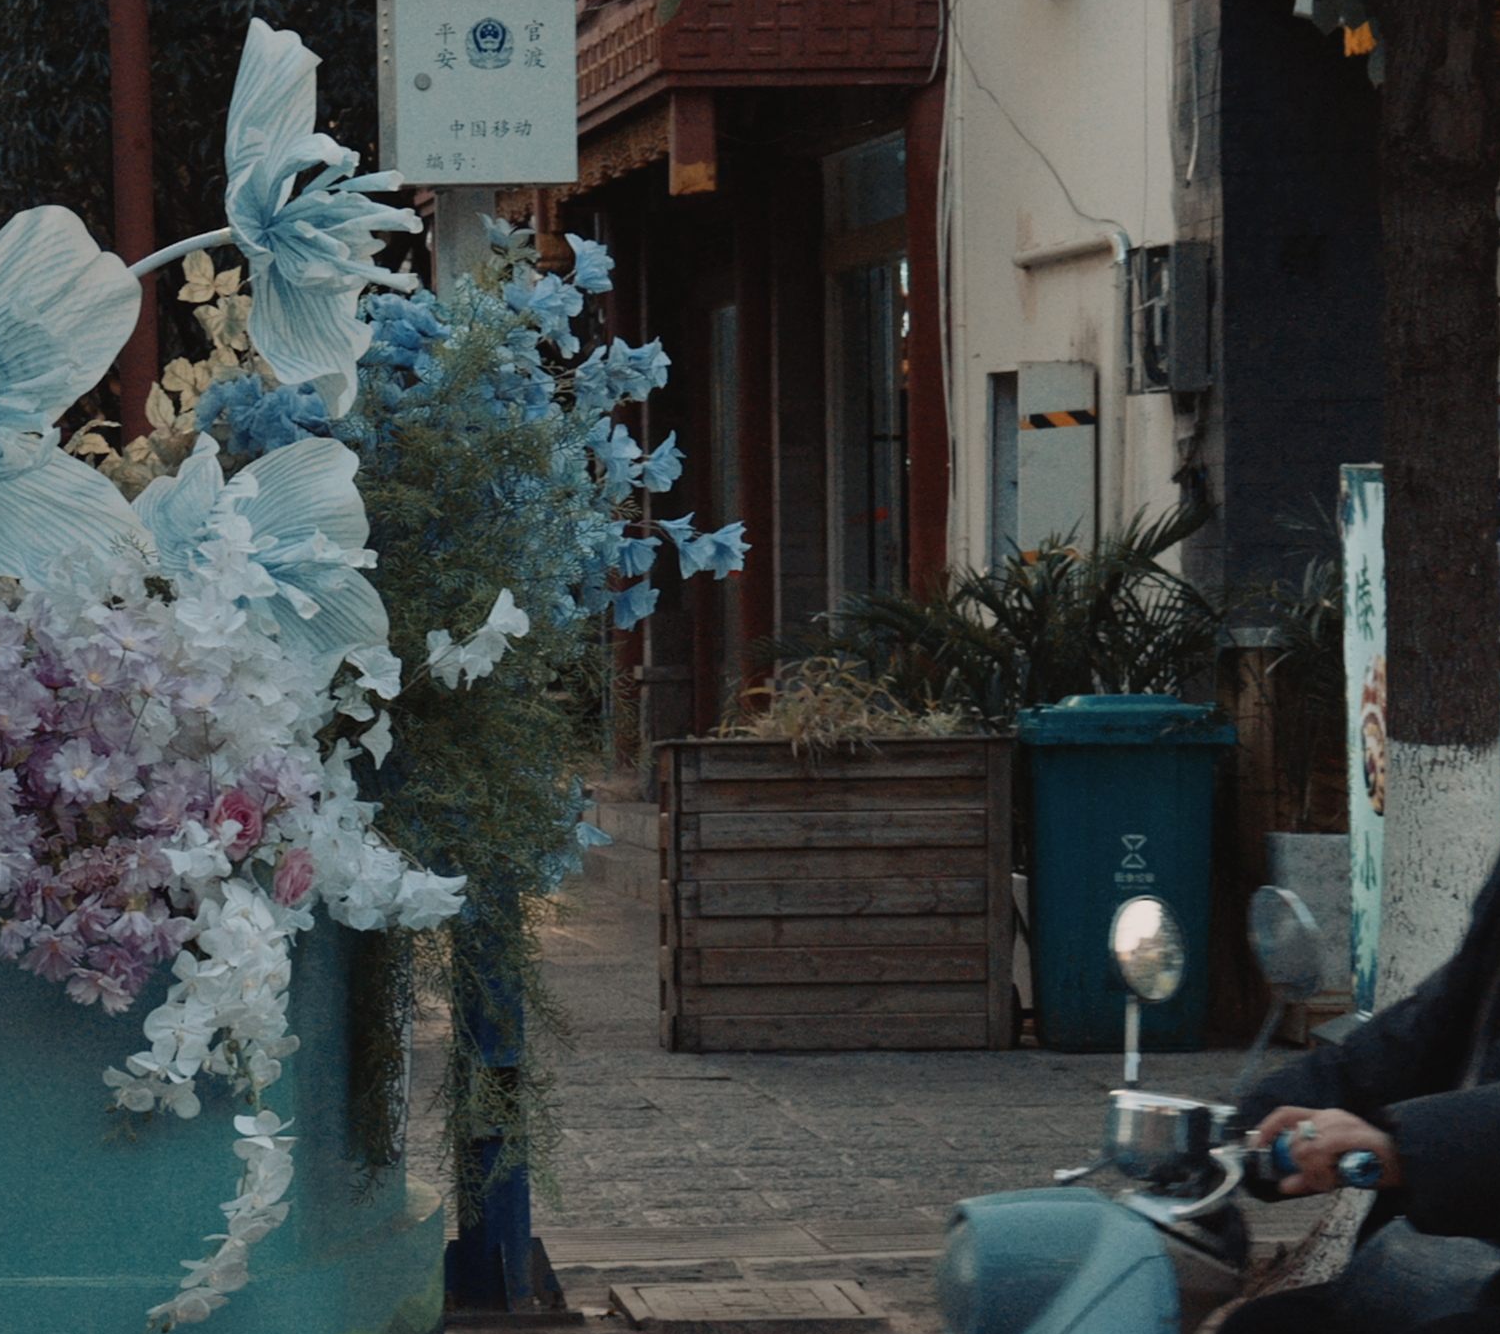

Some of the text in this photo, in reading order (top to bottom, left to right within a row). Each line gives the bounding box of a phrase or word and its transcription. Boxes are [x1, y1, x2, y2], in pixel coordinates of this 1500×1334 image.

[433, 21, 458, 71] 平安
[523, 19, 548, 70] 官渡
[449, 117, 534, 139] 中国移动
